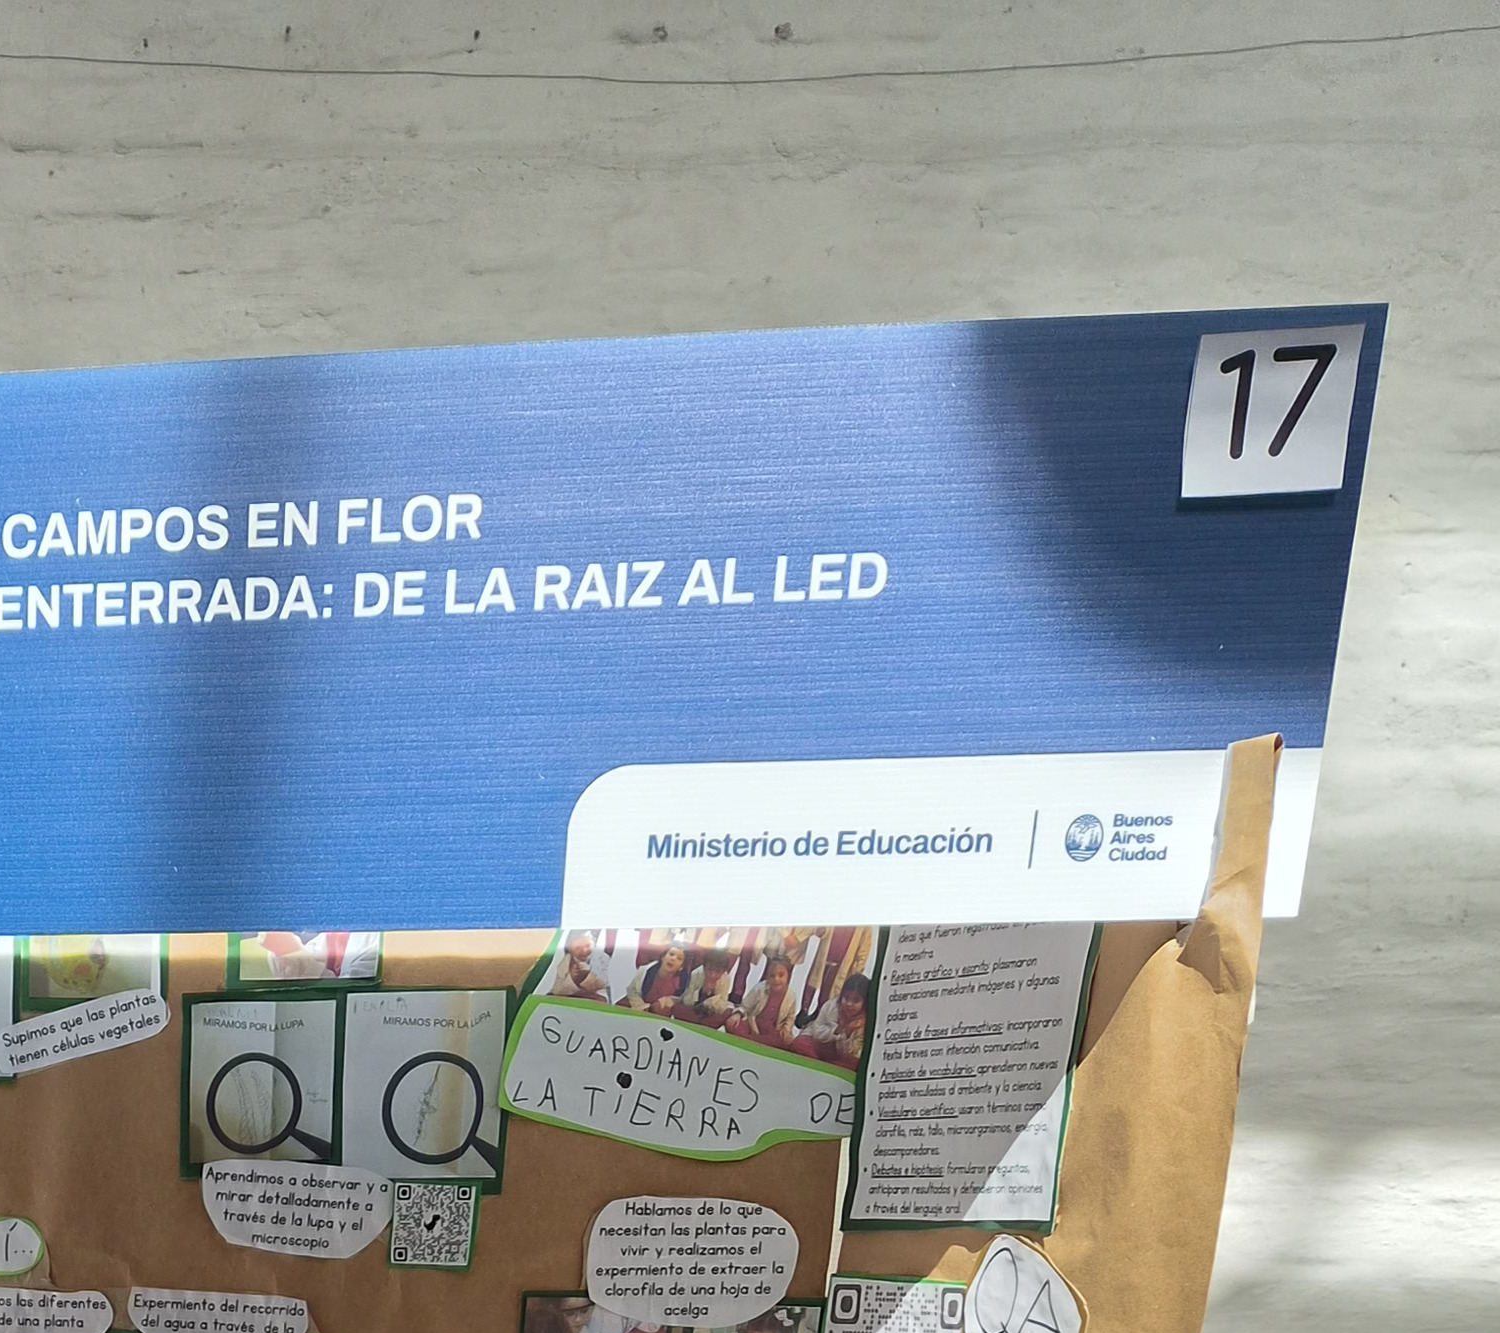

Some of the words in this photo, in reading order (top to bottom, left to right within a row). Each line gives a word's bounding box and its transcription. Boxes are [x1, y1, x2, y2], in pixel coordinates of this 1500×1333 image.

[1220, 344, 1337, 459] 17
[1, 506, 230, 560] CAMPOS
[248, 501, 318, 549] EN
[337, 493, 484, 546] FLOR
[354, 570, 427, 618] DE
[444, 567, 516, 615] LA
[534, 560, 666, 612] RAIZ
[678, 556, 755, 607] AL
[772, 551, 889, 603] LED
[1113, 812, 1174, 828] Buenos
[647, 830, 787, 859] Ministerio
[793, 830, 830, 856] de
[836, 827, 994, 856] Educación
[1109, 829, 1155, 845] Aires
[1108, 846, 1168, 863] Ciudad
[1, 1023, 58, 1048] Supimos
[60, 1016, 84, 1035] que
[85, 1006, 106, 1024] las
[109, 993, 157, 1020] plantas
[9, 1045, 49, 1067] tienen
[52, 1031, 97, 1055] células
[99, 1012, 161, 1044] vegetales
[512, 1077, 557, 1112] LA
[624, 1202, 693, 1217] Hablamos
[697, 1202, 715, 1216] de
[719, 1202, 732, 1216] lo
[737, 1204, 763, 1219] que
[599, 1222, 666, 1238] necesitan
[671, 1222, 691, 1237] las
[694, 1223, 748, 1240] plantas
[752, 1225, 787, 1239] para
[620, 1243, 650, 1257] vivir
[655, 1246, 664, 1259] y
[668, 1242, 745, 1257] realizamos
[750, 1242, 762, 1256] el
[688, 1262, 706, 1276] de
[711, 1264, 768, 1276] extraer
[772, 1262, 784, 1276] la
[604, 1282, 664, 1298] clorofila
[669, 1282, 686, 1298] de
[690, 1284, 716, 1297] una
[719, 1282, 749, 1299] hoja
[754, 1282, 772, 1296] de
[15, 1292, 34, 1309] las
[38, 1294, 108, 1311] diferentes
[663, 1303, 709, 1319] acelga
[17, 1316, 40, 1328] una
[44, 1314, 84, 1331] planta
